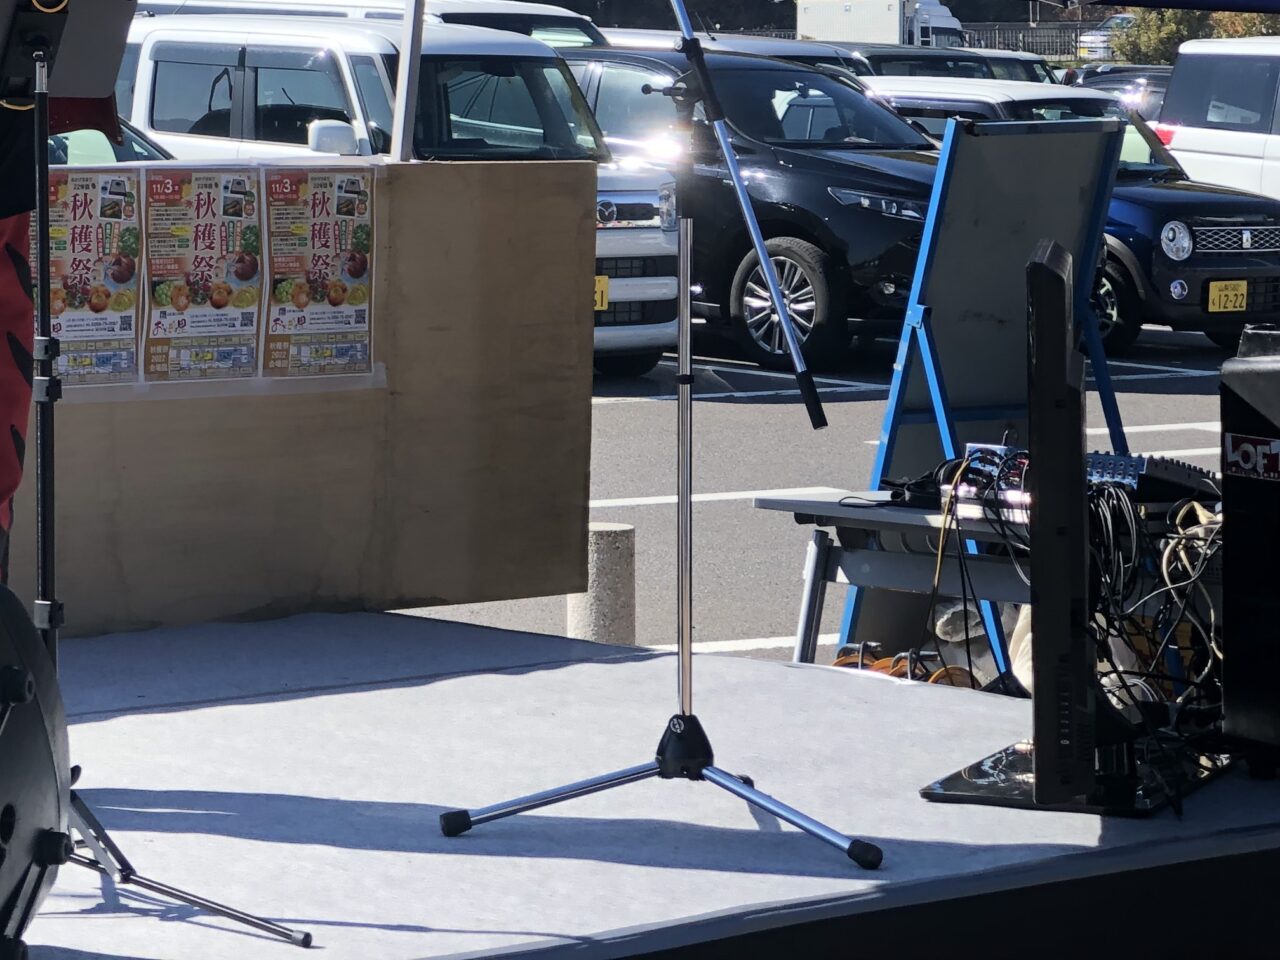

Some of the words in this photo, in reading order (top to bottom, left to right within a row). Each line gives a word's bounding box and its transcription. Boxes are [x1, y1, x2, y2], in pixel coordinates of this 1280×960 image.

[152, 178, 172, 193] 11/3
[271, 178, 290, 192] 11/3
[69, 192, 93, 285] 秋穫祭
[192, 191, 216, 282] 秋穫祭
[309, 190, 330, 279] 秋穫祭
[1218, 292, 1245, 310] 12-22
